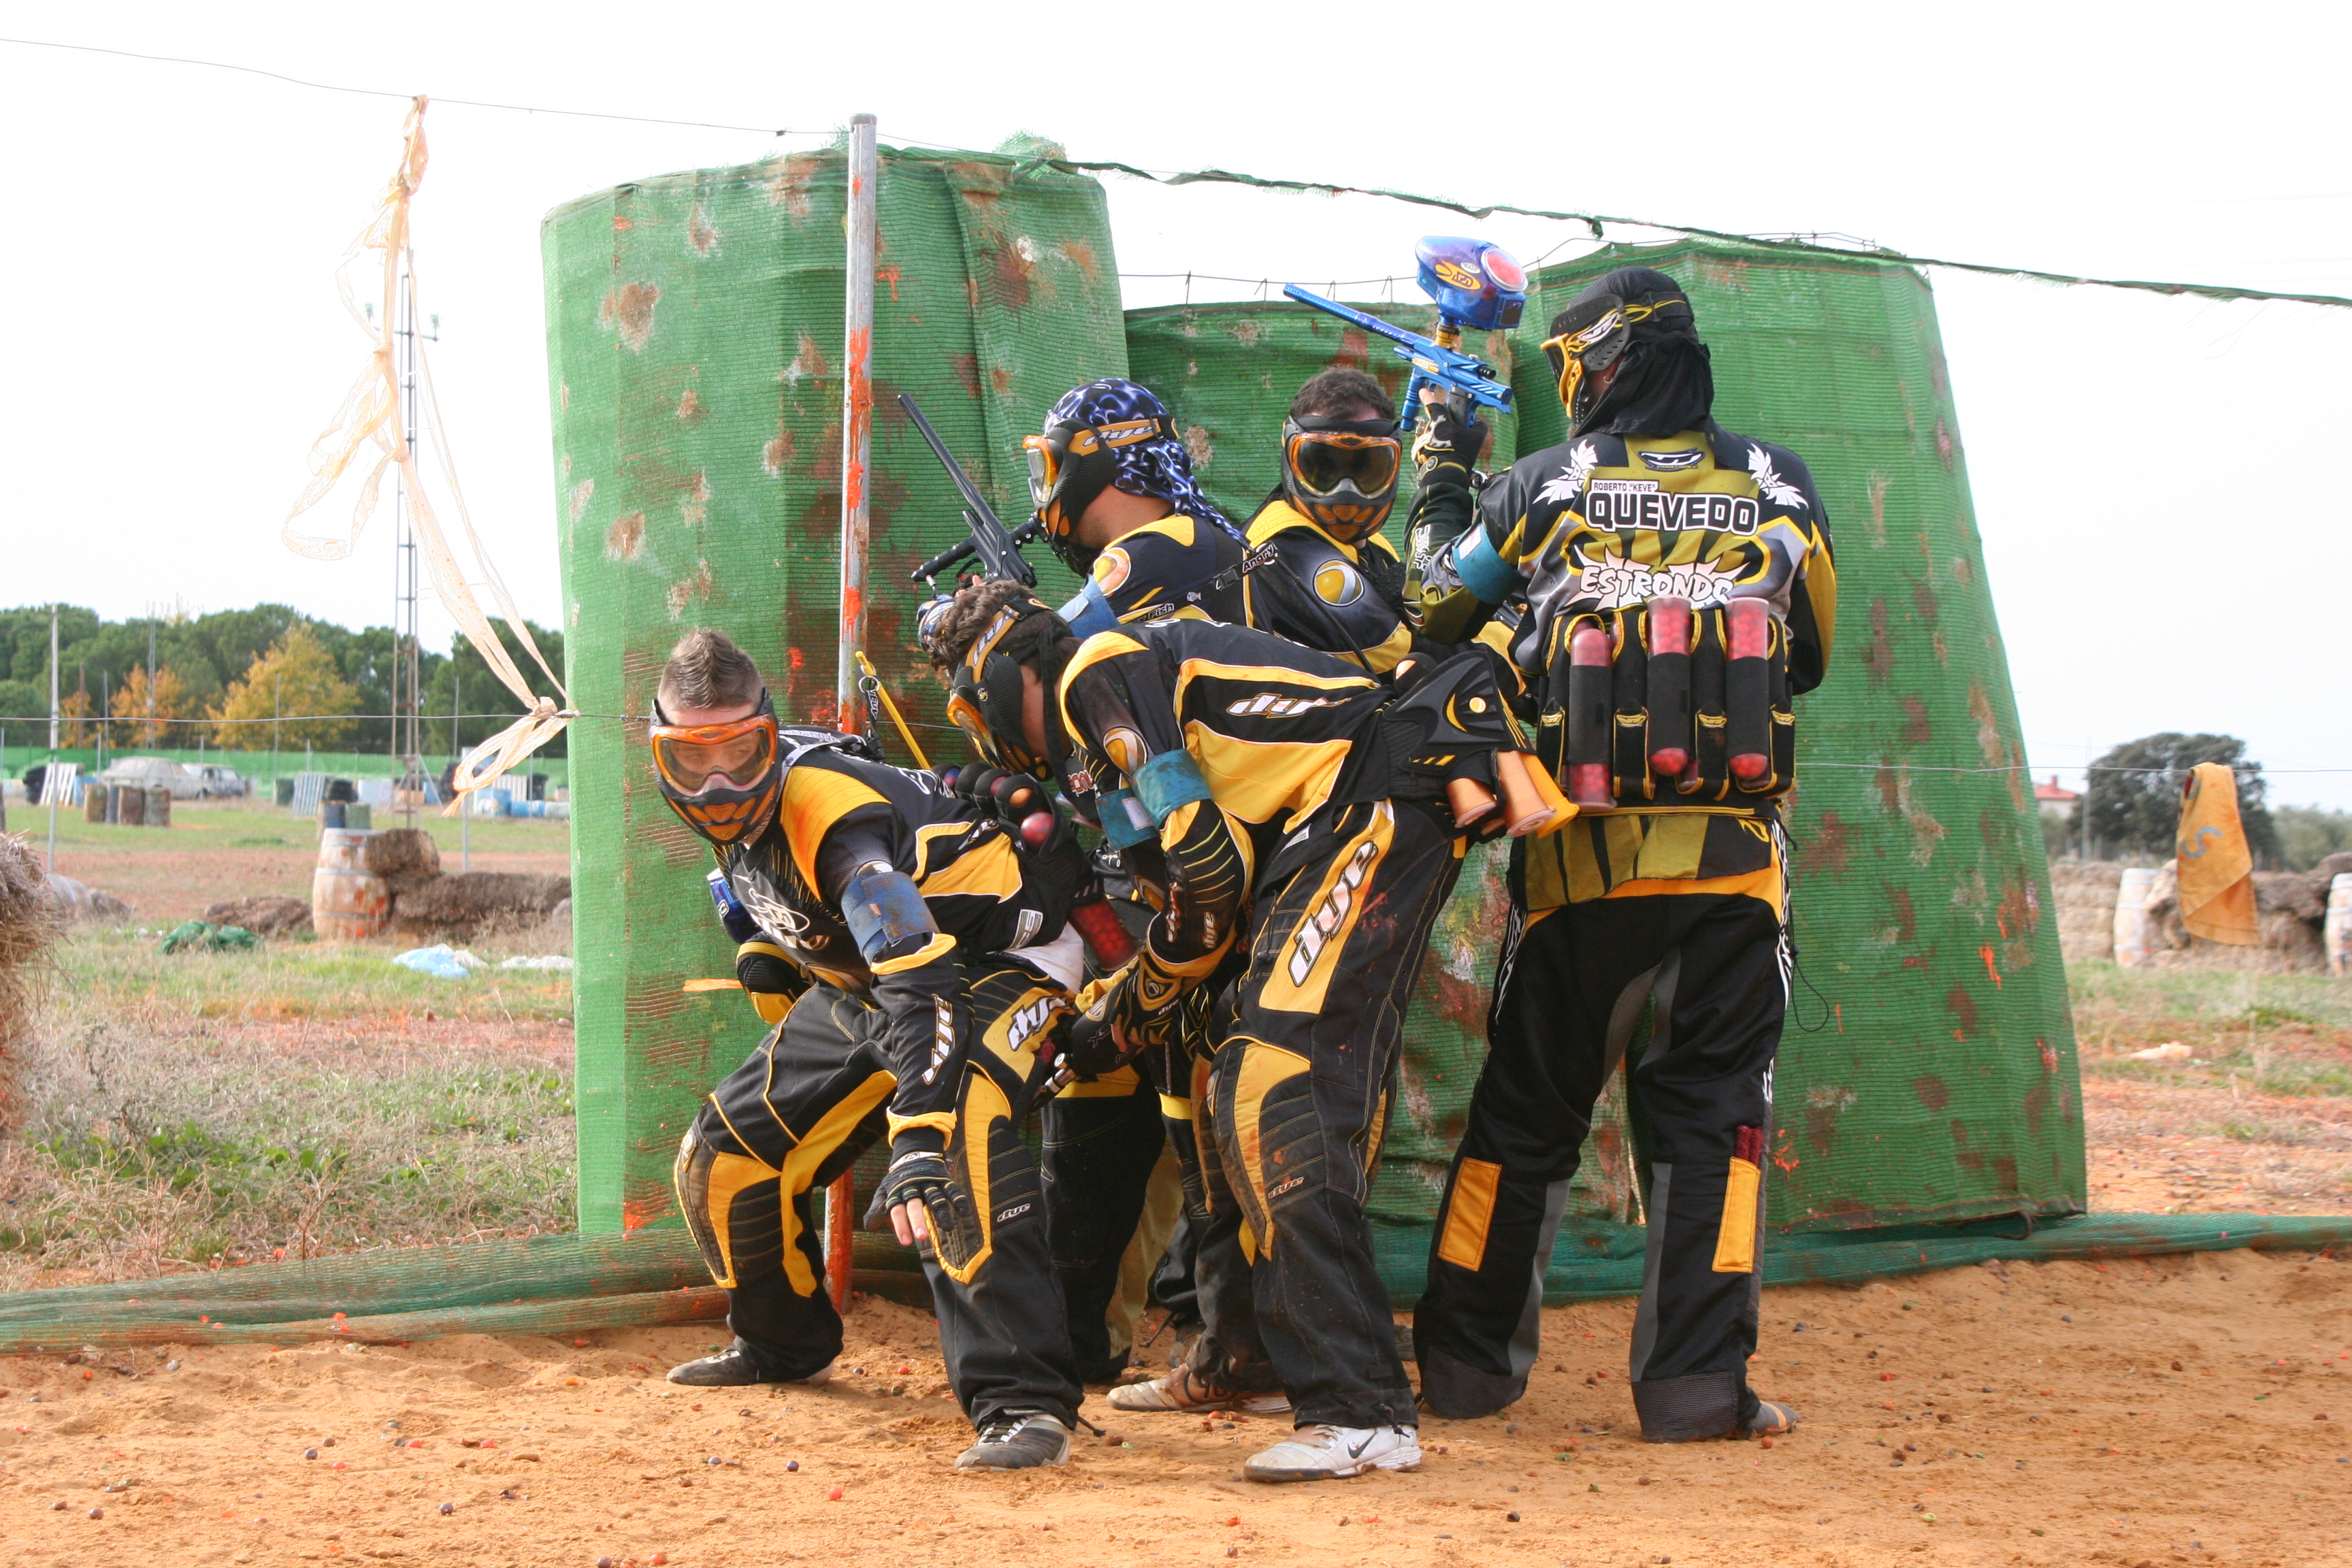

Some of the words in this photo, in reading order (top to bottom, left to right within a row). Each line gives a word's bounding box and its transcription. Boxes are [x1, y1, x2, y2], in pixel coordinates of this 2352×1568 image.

[1594, 482, 1627, 491] ROBERTO
[1588, 491, 1757, 535] QUEVEDO
[1580, 565, 1735, 604] ESTRONDO
[1288, 840, 1379, 987] dye
[997, 1203, 1031, 1223] dye
